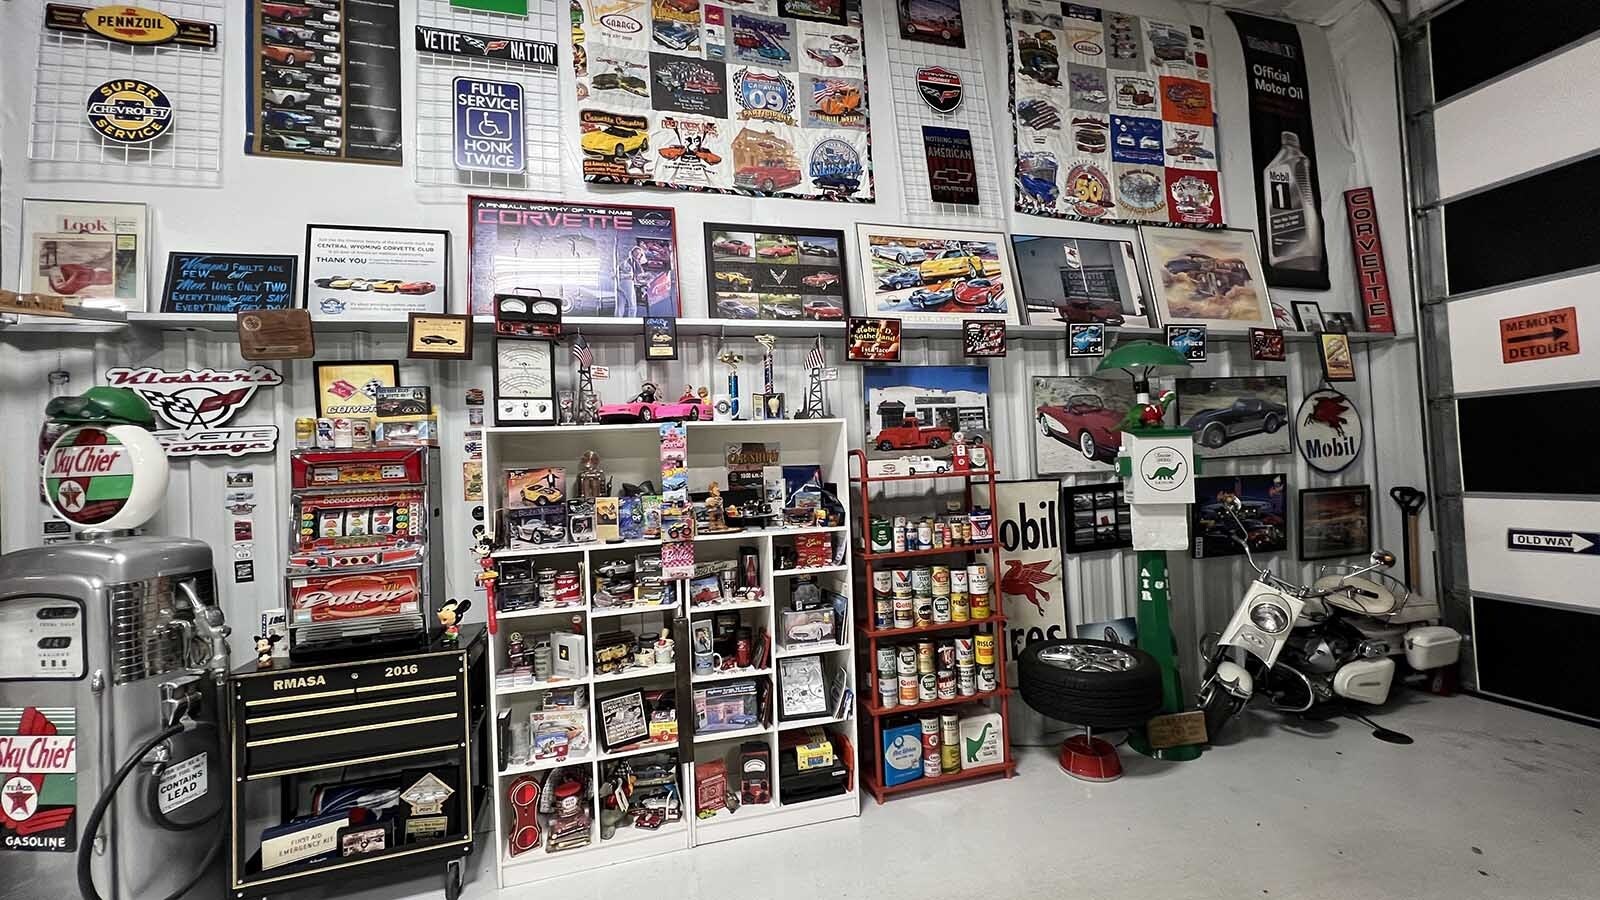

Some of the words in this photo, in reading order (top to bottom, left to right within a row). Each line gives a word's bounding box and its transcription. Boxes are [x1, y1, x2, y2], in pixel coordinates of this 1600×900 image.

[97, 15, 164, 30] PENNZOIL
[510, 41, 554, 65] NATION
[1253, 64, 1290, 84] Official
[100, 81, 160, 101] SUPER
[471, 83, 506, 97] FULL
[1255, 78, 1286, 96] Motor
[1288, 86, 1303, 100] Oil
[458, 94, 519, 110] SERVICE
[749, 89, 784, 110] 09
[92, 103, 168, 119] CHEVROLET
[96, 119, 163, 140] SERVICE
[464, 139, 513, 154] HONK
[928, 147, 972, 160] AMERICAN
[465, 153, 515, 167] TWICE
[1270, 170, 1290, 181] Mobil
[933, 185, 974, 193] CHEVROLET
[1276, 183, 1285, 208] 1
[64, 218, 109, 234] Look
[478, 209, 633, 230] CORVETTE
[349, 257, 368, 265] YOU
[1350, 191, 1388, 317] CORVETTE
[264, 281, 287, 292] TWO
[172, 292, 231, 302] EVERYTHING
[175, 303, 234, 313] EVERYTHING
[1506, 313, 1567, 332] MEMORY
[1508, 341, 1569, 360] DETOUR
[1306, 436, 1355, 459] Mobil
[50, 448, 74, 476] Sky
[75, 443, 121, 472] Chief
[1000, 501, 1058, 551] obil
[1517, 535, 1541, 546] OLD
[1543, 537, 1573, 548] WAY
[666, 549, 691, 561] Barbie
[300, 588, 414, 608] Pulsar
[273, 674, 326, 690] RMASA
[385, 664, 418, 677] 2016
[0, 738, 28, 770] Sky
[27, 737, 75, 769] Chief
[6, 783, 32, 792] TEXACO
[160, 769, 203, 794] CONTAINS
[168, 782, 197, 801] LEAD
[5, 836, 66, 848] GASOLINE
[279, 840, 320, 857] EMERGENCY
[323, 836, 333, 844] KIT
[290, 835, 310, 845] FIRST
[311, 832, 322, 840] AID
